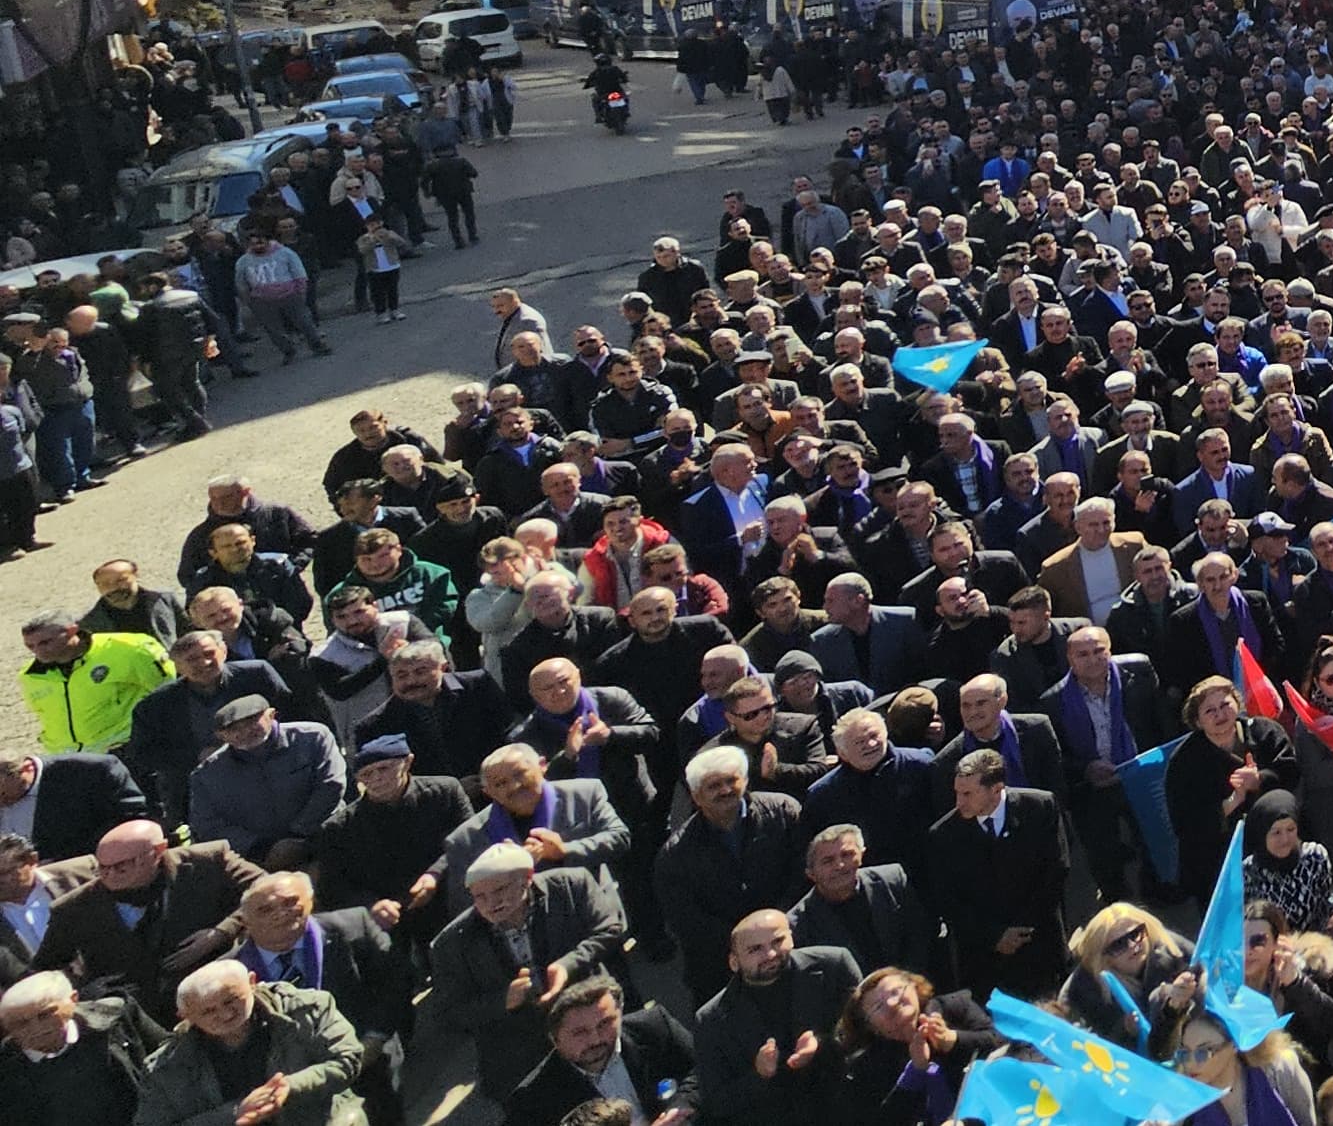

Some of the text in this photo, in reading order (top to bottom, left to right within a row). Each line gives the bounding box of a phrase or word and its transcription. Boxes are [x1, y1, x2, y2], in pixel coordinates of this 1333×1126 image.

[681, 1, 714, 22] DEVAM
[804, 2, 835, 21] DEVAM
[1040, 4, 1078, 21] DEVAM
